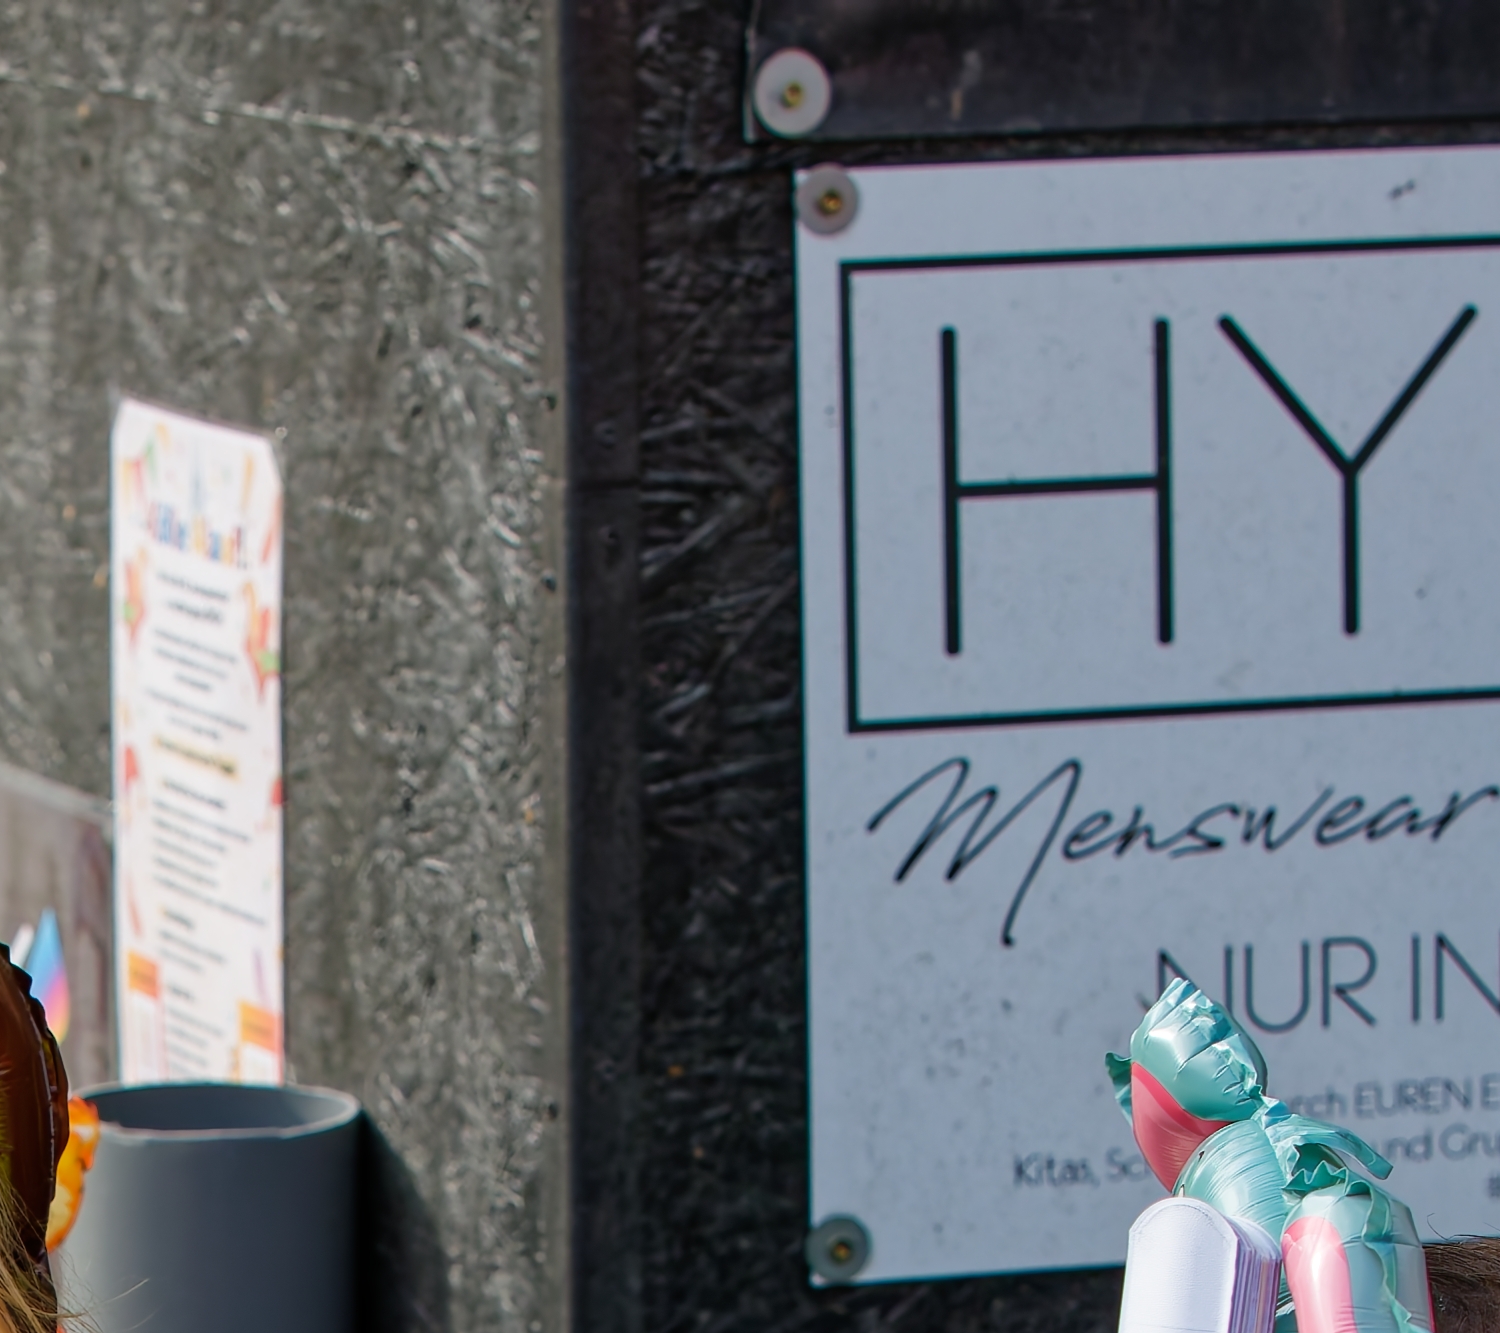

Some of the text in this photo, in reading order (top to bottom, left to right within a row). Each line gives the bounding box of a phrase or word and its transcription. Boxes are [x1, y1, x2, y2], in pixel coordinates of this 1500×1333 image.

[866, 757, 1500, 947] Menswear
[1140, 936, 1378, 1033] NUR
[1354, 1074, 1474, 1119] EUREN
